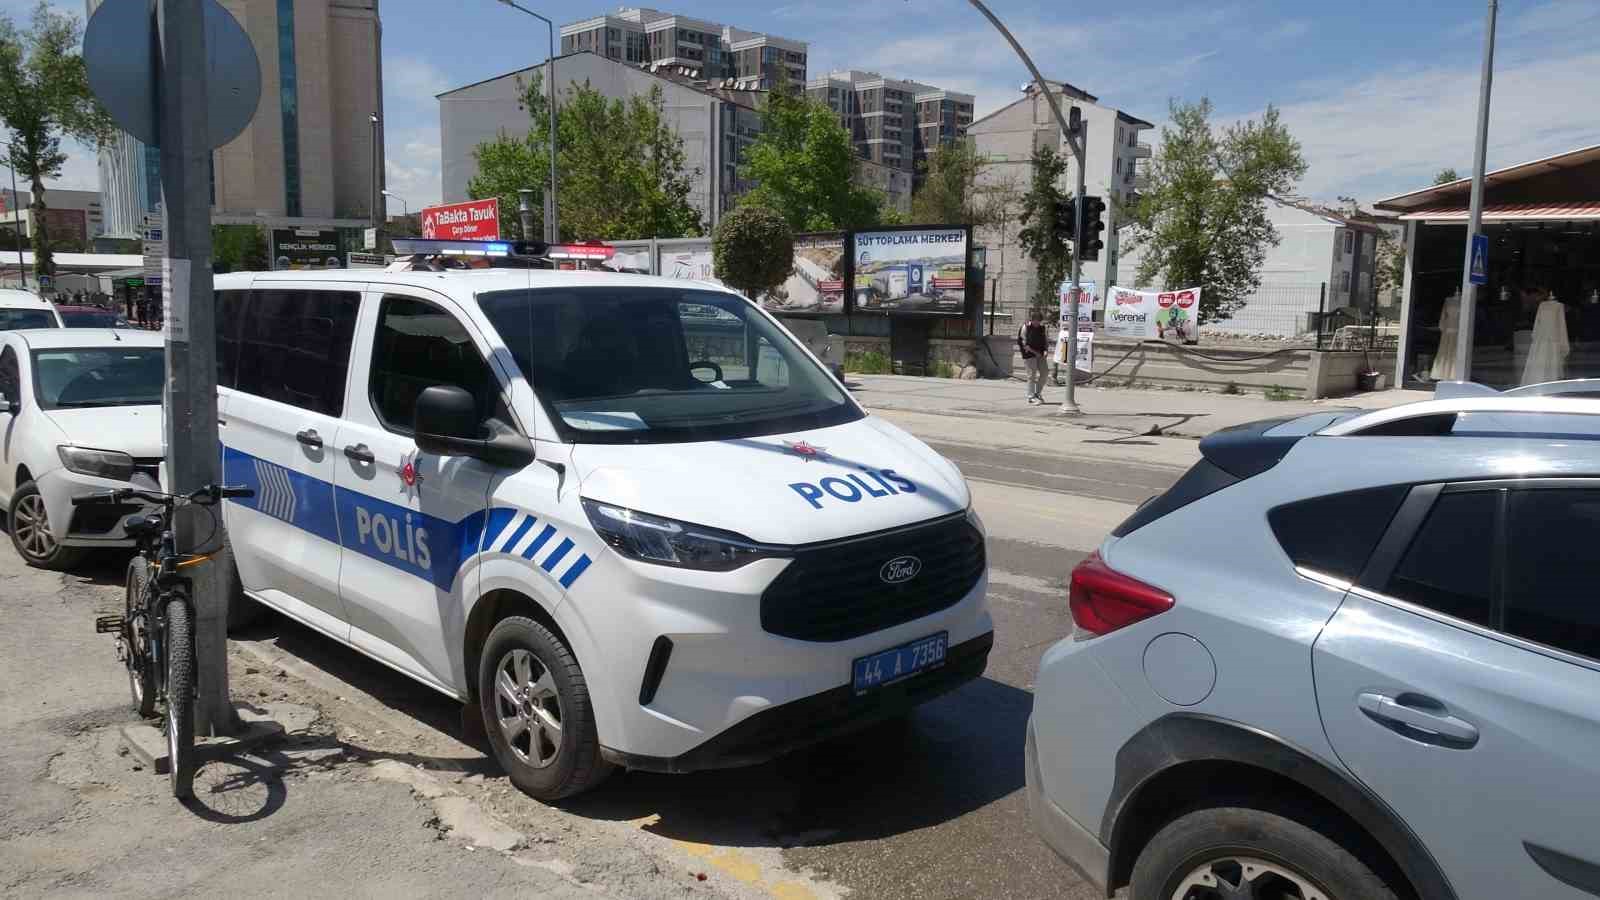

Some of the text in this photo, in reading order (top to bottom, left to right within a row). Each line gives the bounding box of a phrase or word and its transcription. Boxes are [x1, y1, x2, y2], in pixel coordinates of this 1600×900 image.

[435, 204, 495, 225] TaBakta Tavuk
[858, 231, 963, 246] SÜT TOPLAMA MERKEZİ
[786, 465, 917, 509] POLİS
[356, 506, 432, 570] POLİS
[887, 560, 914, 580] Ford
[864, 639, 945, 685] 44 A 7356
